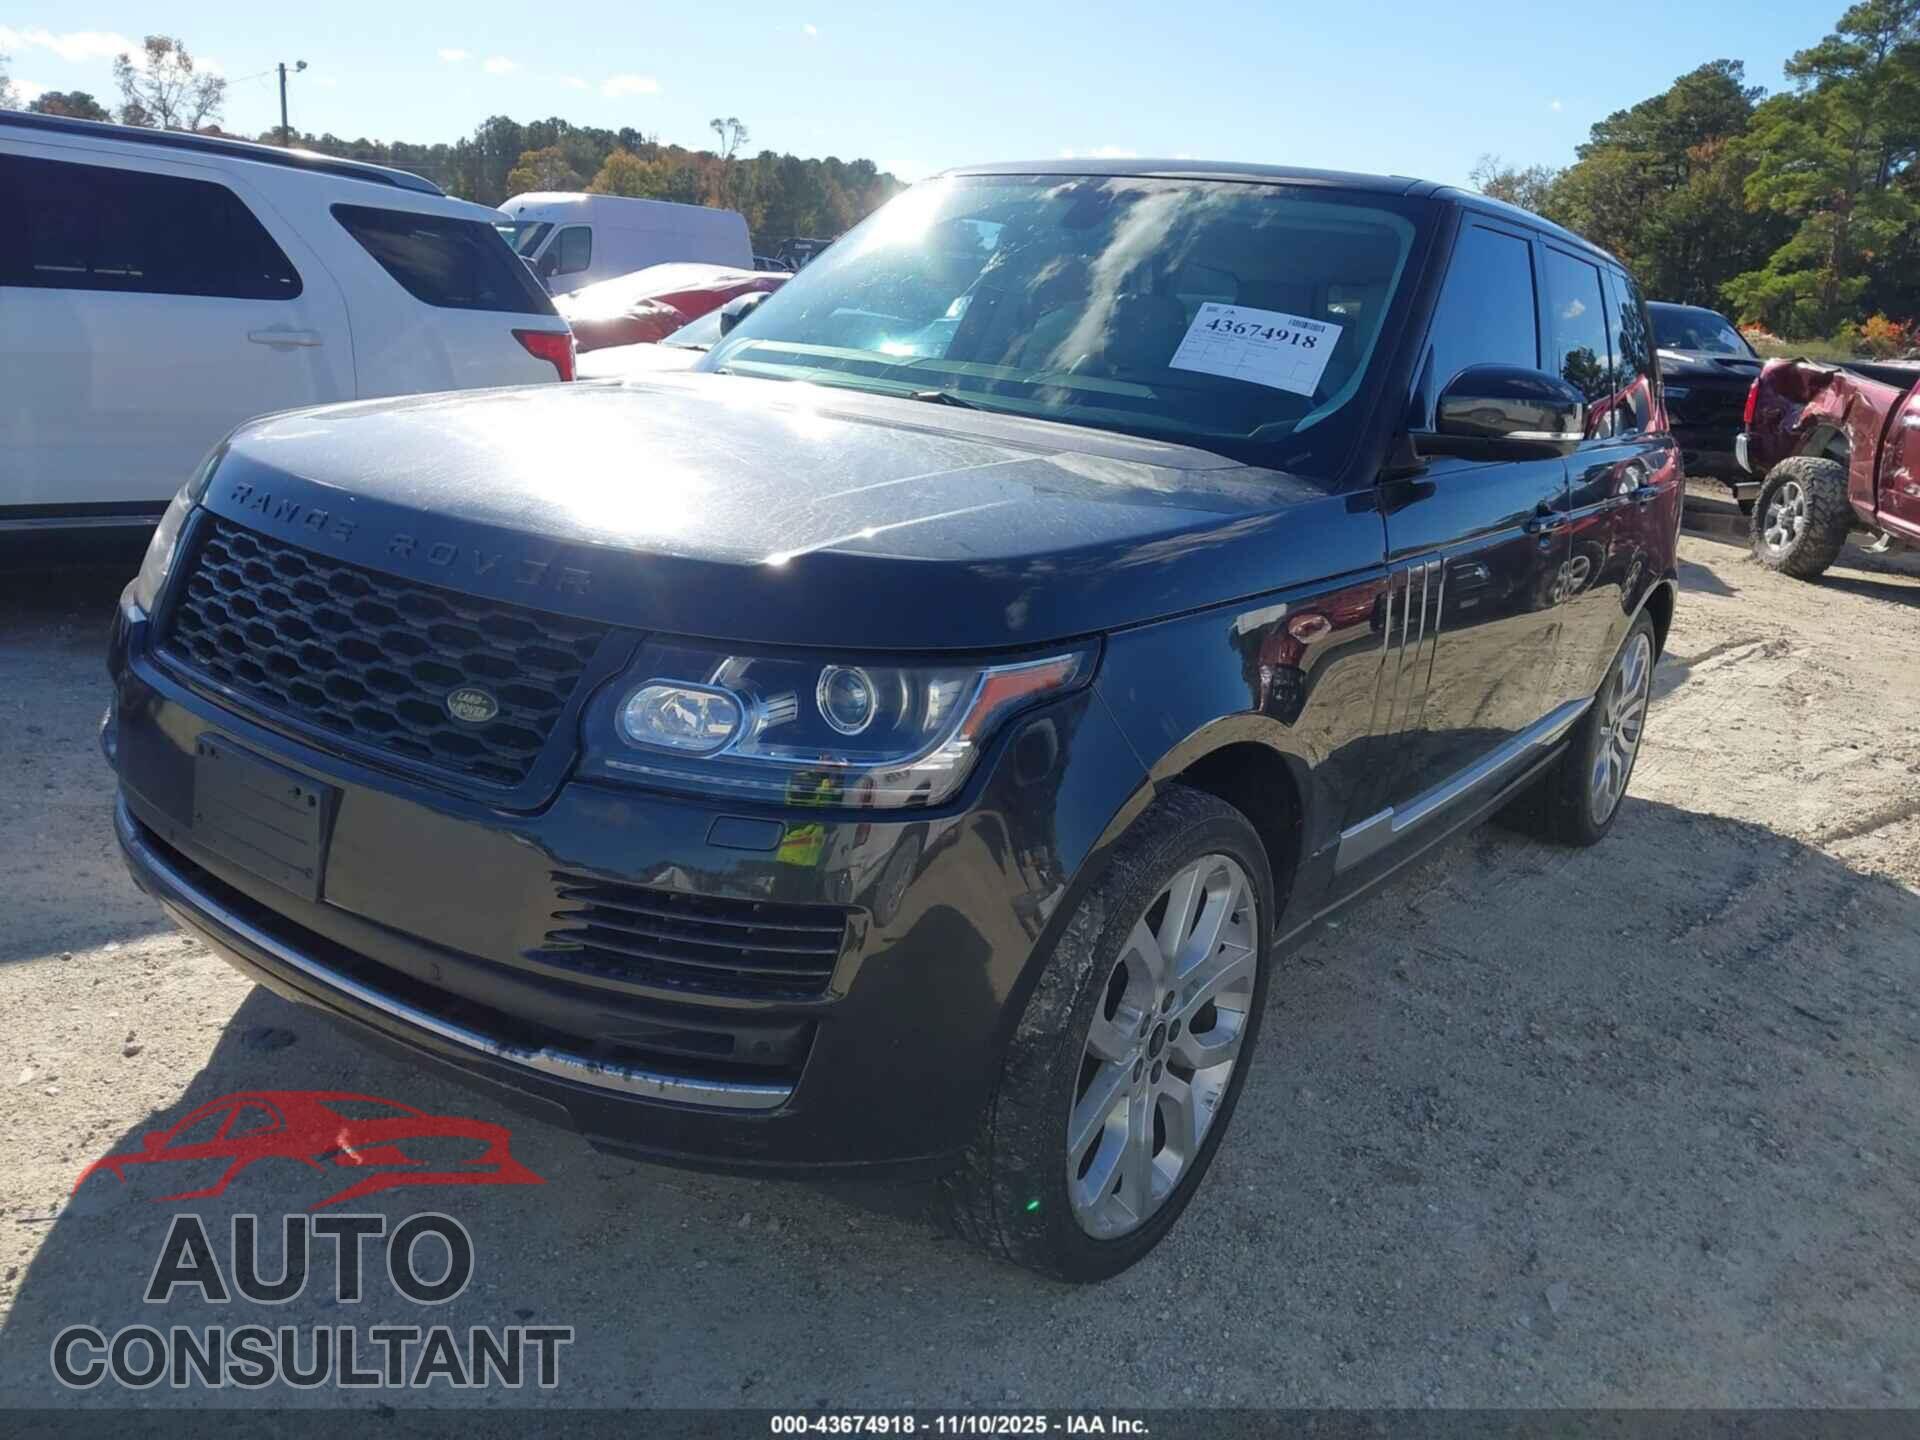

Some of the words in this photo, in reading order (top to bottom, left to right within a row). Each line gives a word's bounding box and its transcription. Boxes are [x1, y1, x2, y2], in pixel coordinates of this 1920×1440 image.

[1205, 318, 1318, 349] 43674918
[231, 482, 359, 543] RANGE
[385, 533, 593, 595] ROVER
